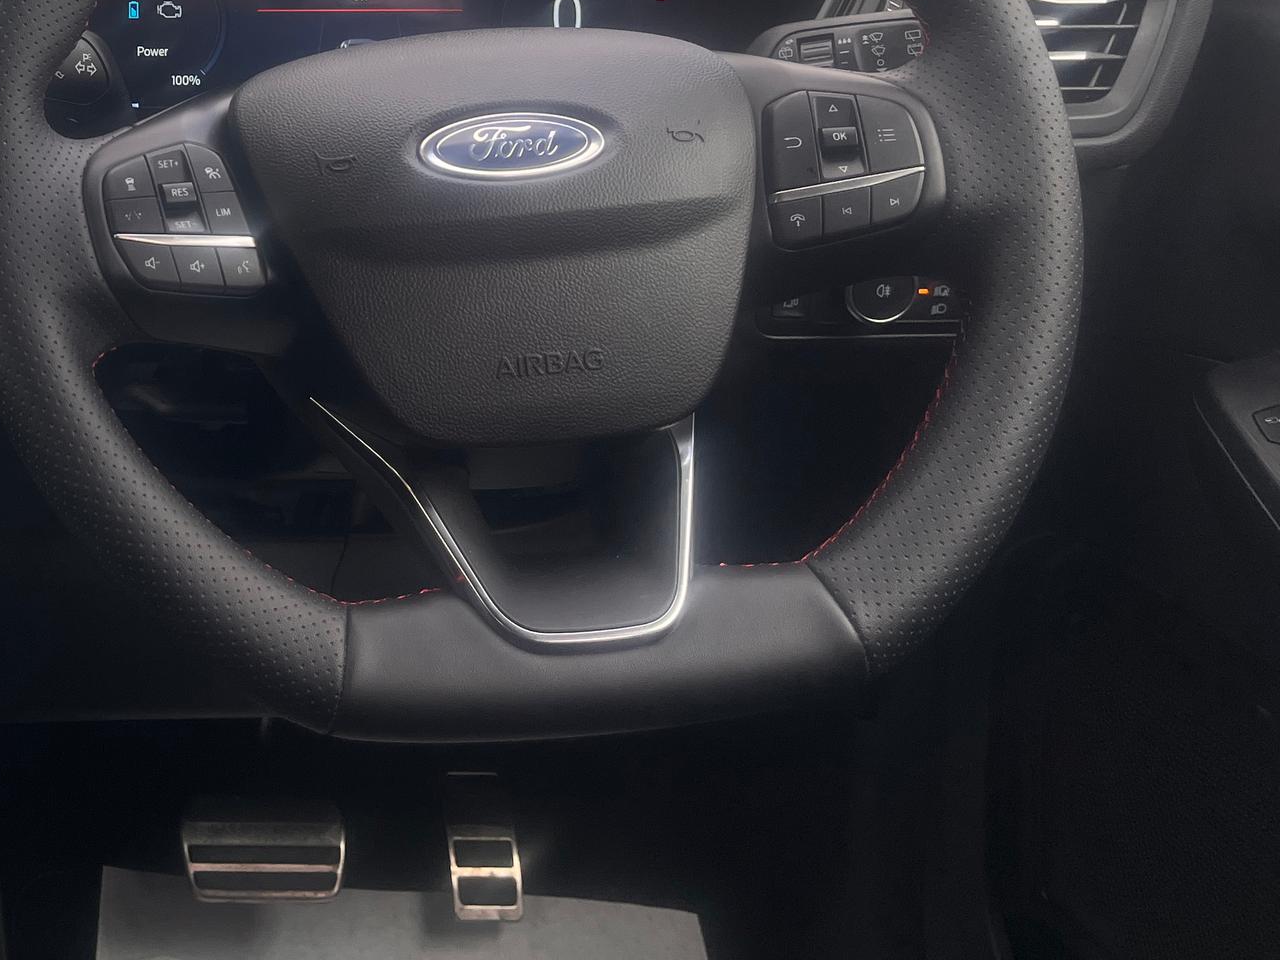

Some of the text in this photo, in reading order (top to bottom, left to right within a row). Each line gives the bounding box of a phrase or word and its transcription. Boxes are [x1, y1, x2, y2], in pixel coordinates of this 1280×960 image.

[136, 45, 169, 57] Power
[171, 74, 201, 86] 100%
[832, 131, 847, 141] OK
[472, 125, 558, 162] Ford
[171, 187, 189, 197] RES
[215, 207, 231, 217] LIM
[496, 347, 605, 379] AIRBAG
